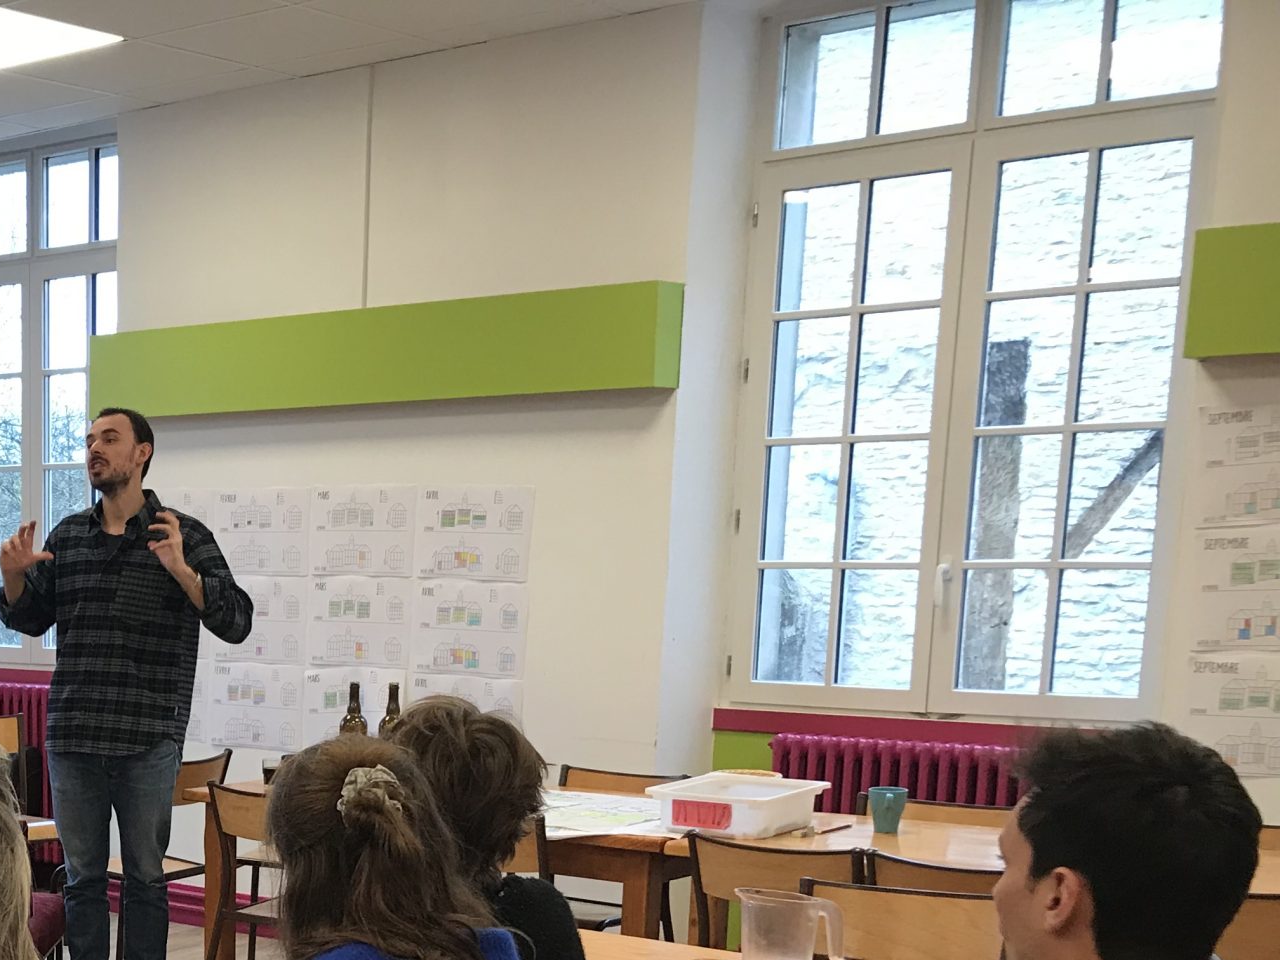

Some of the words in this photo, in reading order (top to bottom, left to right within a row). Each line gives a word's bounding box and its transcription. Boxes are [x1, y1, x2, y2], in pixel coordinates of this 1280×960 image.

[1207, 409, 1253, 425] SEPTEMBRE
[1203, 537, 1250, 551] SEPTEMBRE
[1193, 660, 1241, 674] SEPTEMBRE
